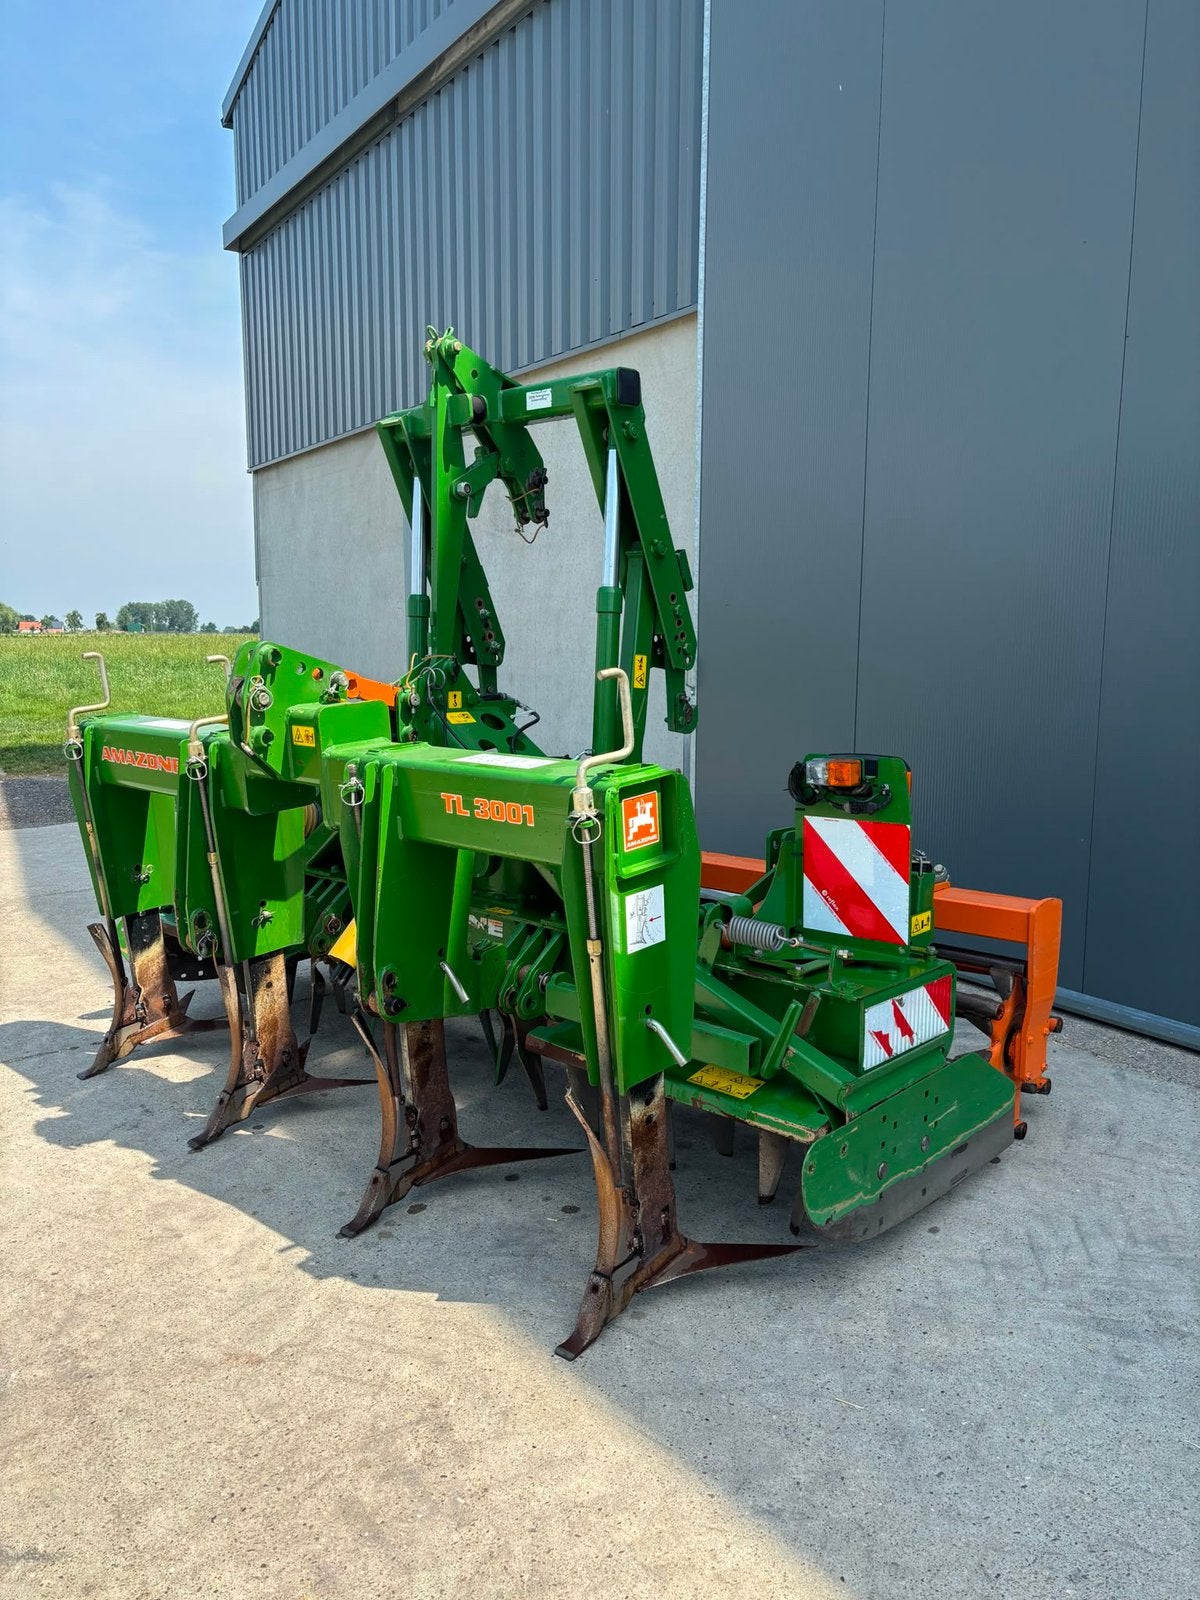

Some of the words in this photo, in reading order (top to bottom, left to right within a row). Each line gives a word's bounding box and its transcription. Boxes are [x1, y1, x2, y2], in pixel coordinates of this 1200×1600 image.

[440, 792, 470, 817] TL
[473, 797, 535, 827] 3001
[626, 833, 658, 848] AMAZONE
